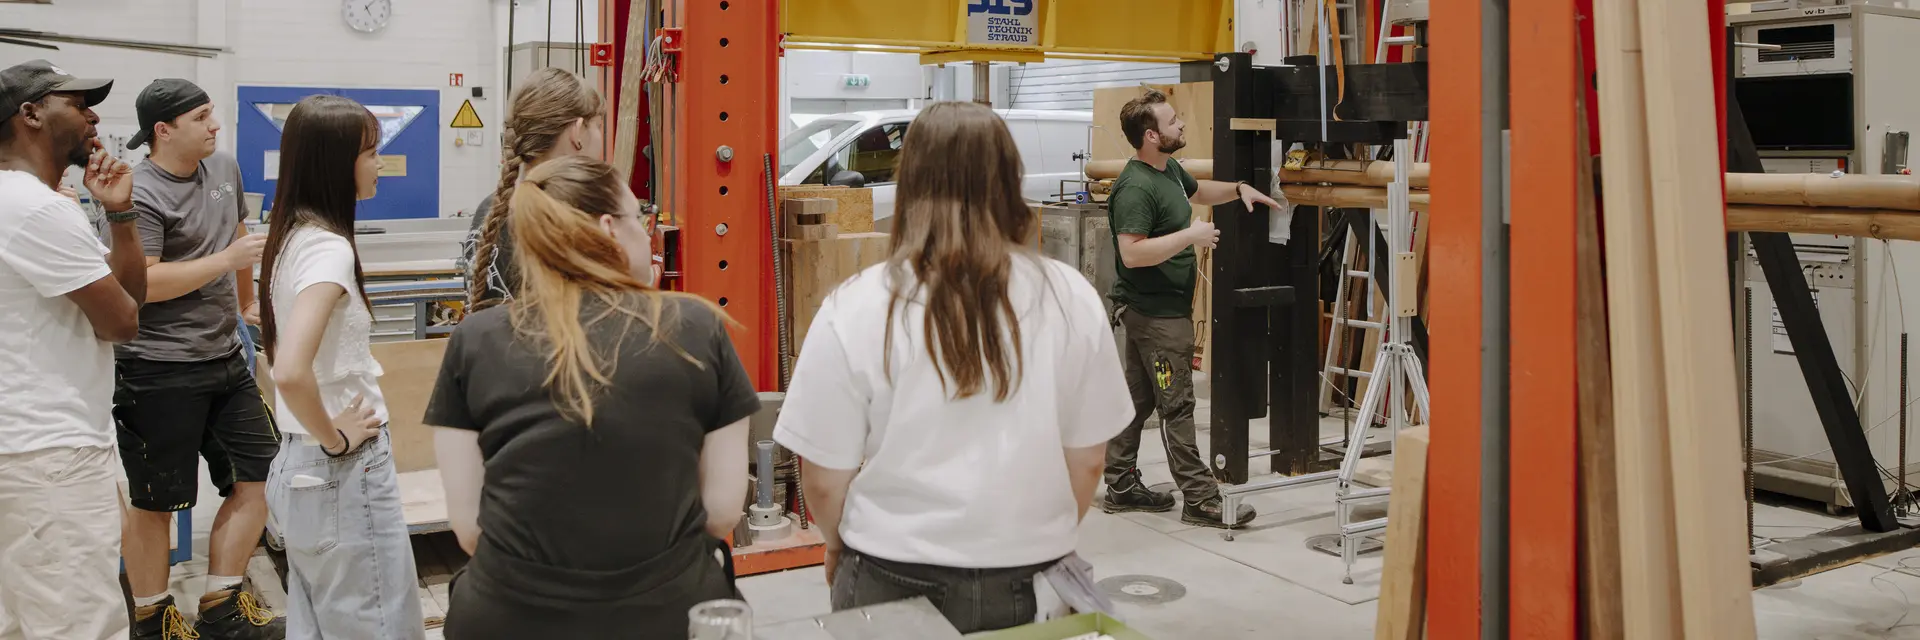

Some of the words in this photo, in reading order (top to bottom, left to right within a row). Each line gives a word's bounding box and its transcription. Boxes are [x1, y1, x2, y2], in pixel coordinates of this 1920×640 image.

[988, 17, 1020, 26] STAHL
[988, 25, 1032, 34] TECHNIK
[988, 33, 1028, 42] STRAUB
